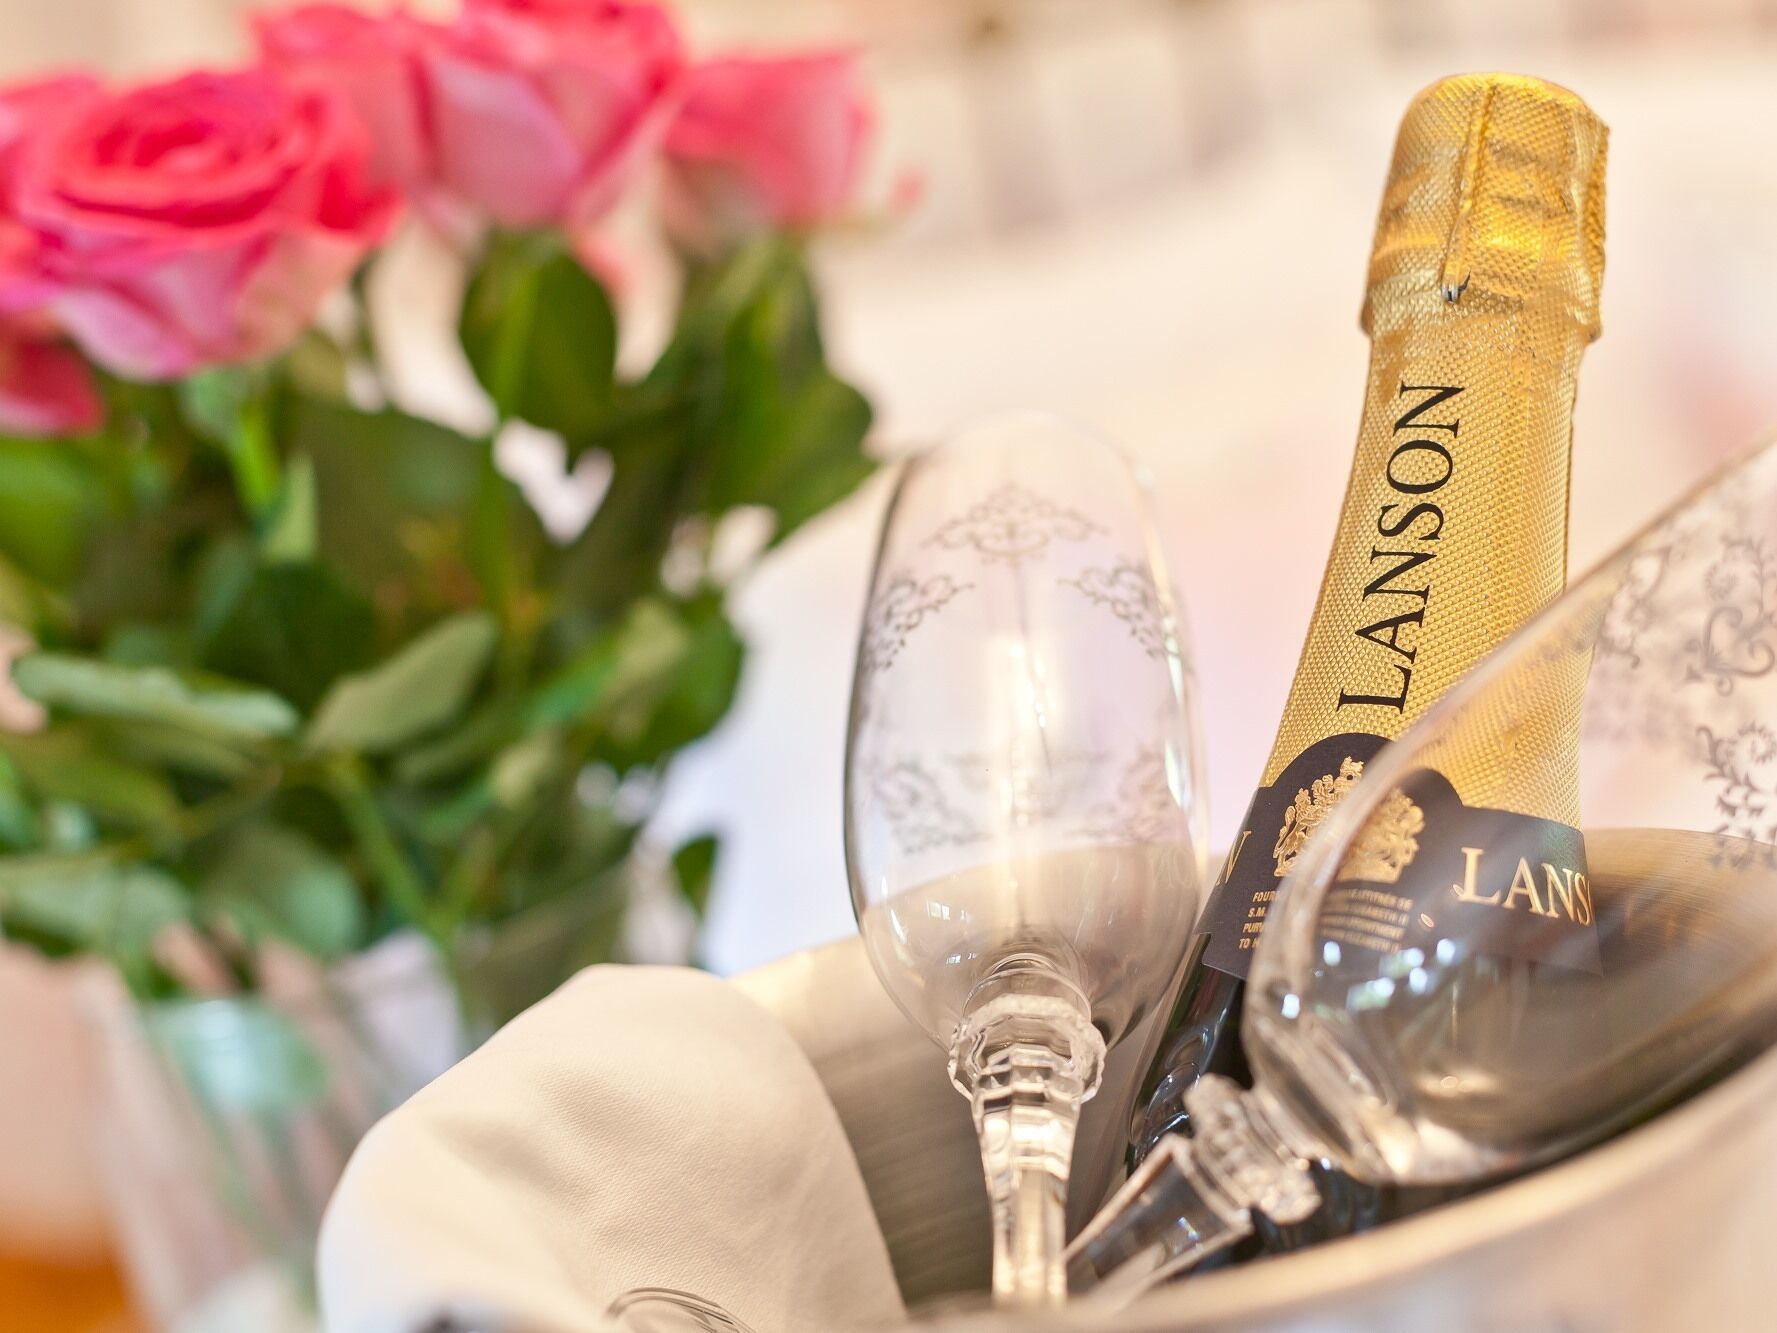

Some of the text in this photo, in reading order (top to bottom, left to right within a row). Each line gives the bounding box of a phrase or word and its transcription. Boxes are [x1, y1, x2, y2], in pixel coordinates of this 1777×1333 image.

[1337, 380, 1465, 714] LANSON
[1457, 846, 1594, 928] LANS
[1238, 938, 1251, 950] TO
